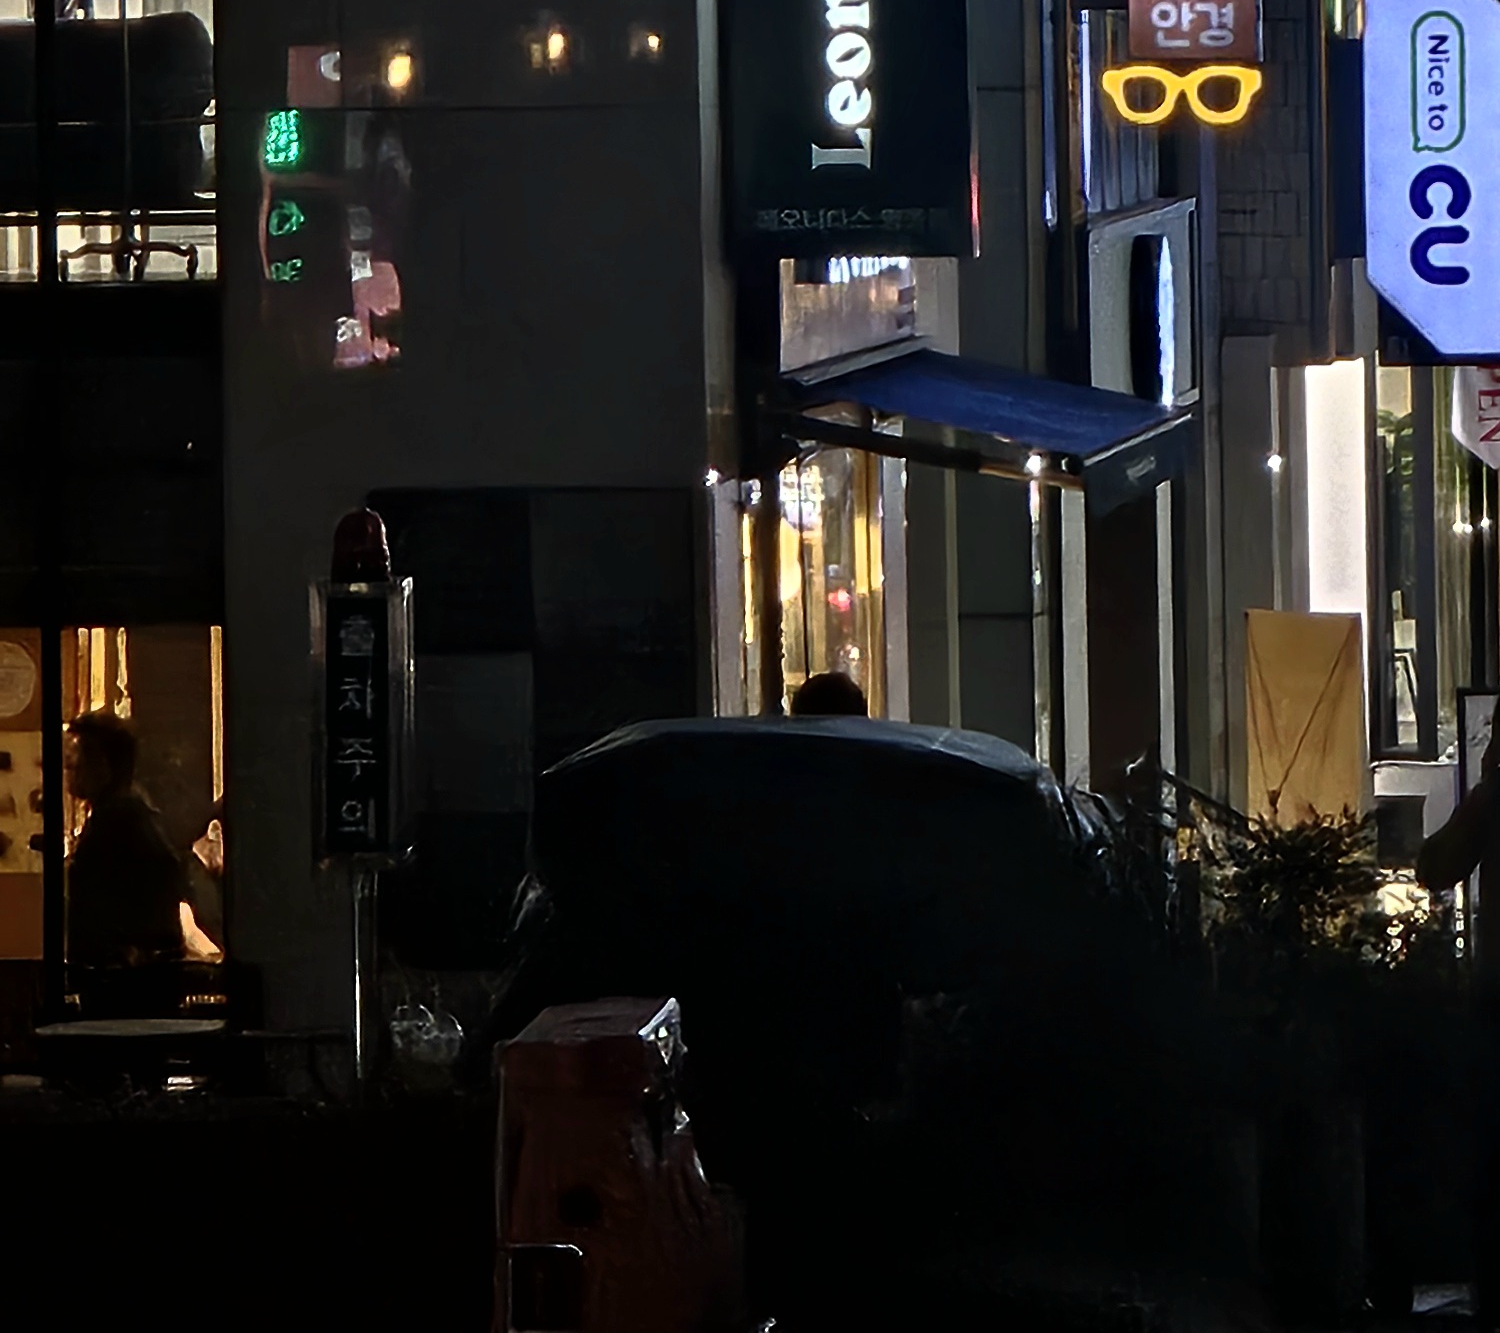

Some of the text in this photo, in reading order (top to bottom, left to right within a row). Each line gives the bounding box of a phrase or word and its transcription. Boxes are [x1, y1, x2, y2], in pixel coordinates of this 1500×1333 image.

[1151, 1, 1235, 48] 안경
[1428, 35, 1450, 131] Nice to
[1409, 164, 1472, 285] CU
